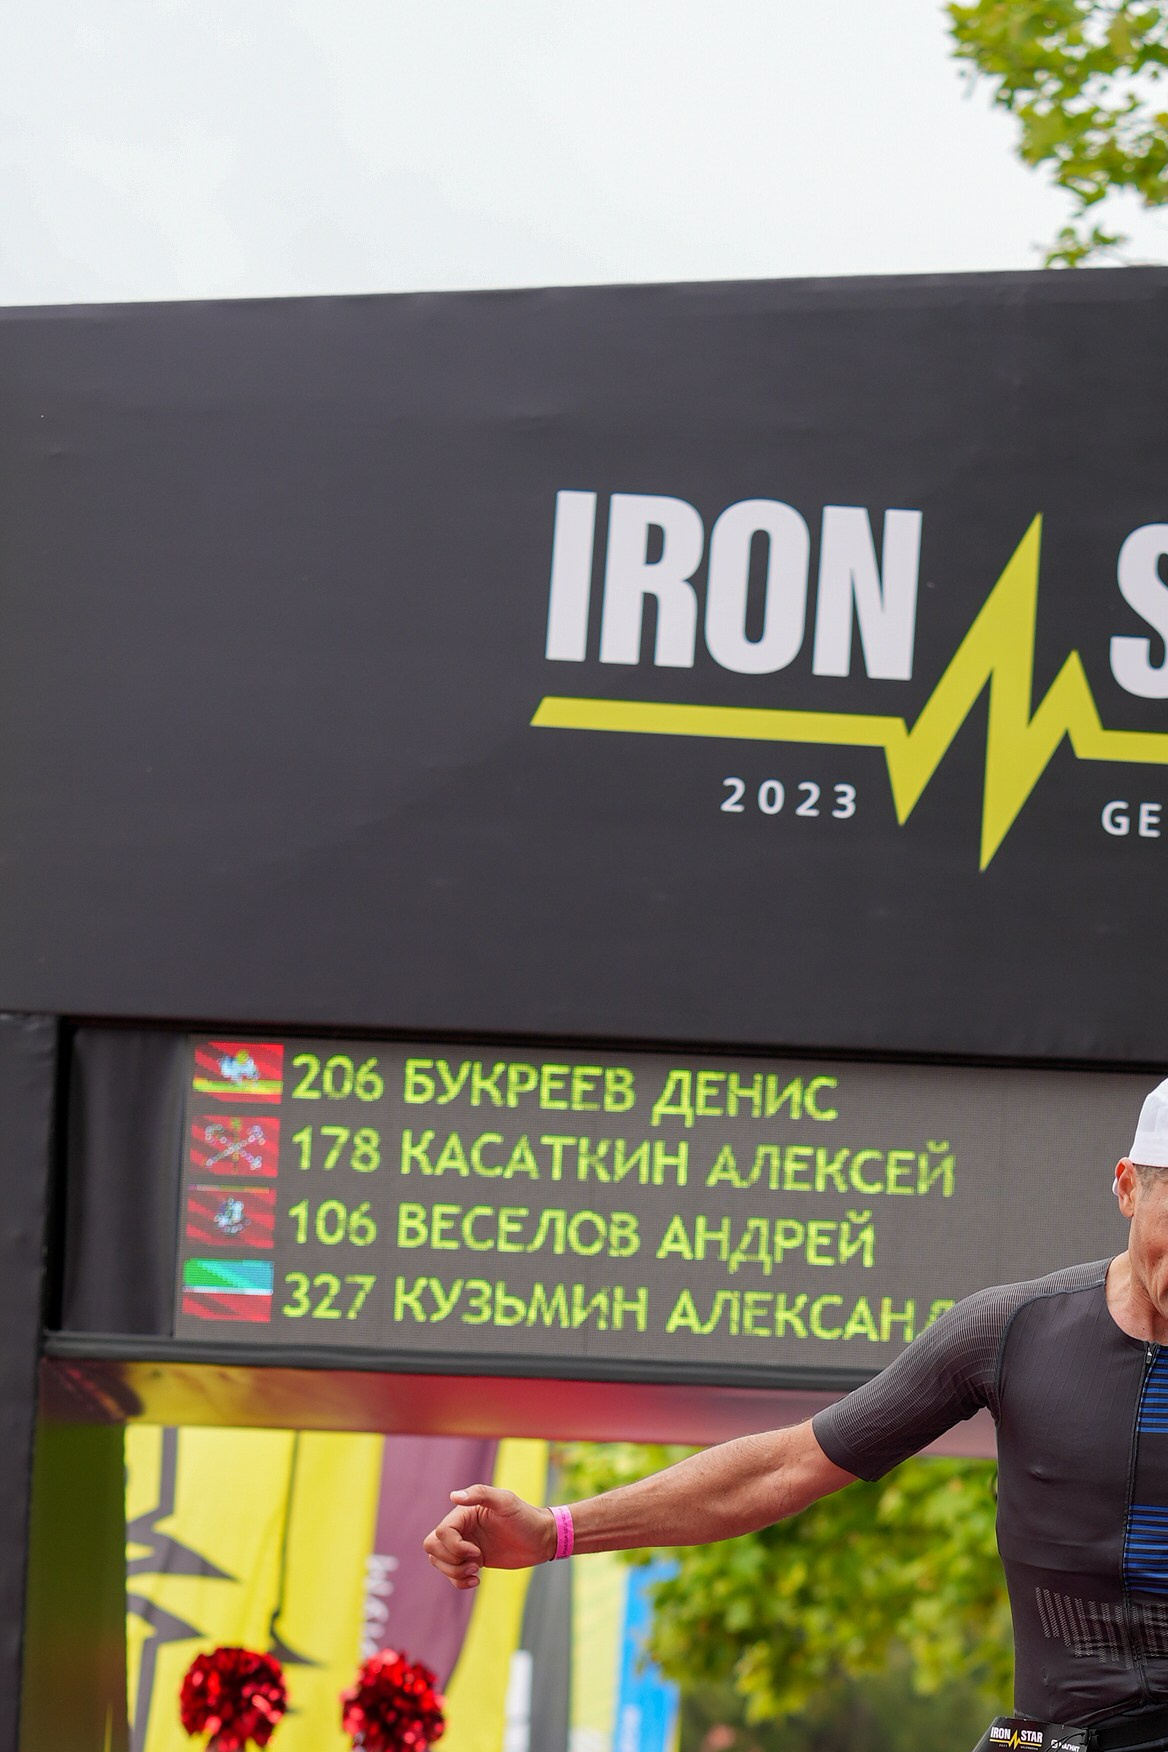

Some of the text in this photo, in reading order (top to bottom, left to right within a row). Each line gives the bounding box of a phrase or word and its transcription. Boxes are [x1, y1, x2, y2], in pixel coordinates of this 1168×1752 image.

[545, 490, 923, 680] IRON
[719, 776, 858, 819] 2023
[291, 1053, 385, 1103] 206
[403, 1057, 638, 1113] БУКРЕЕВ
[651, 1067, 839, 1127] ДЕНИС
[291, 1126, 382, 1174] 178
[399, 1129, 689, 1187] КАСАТКИН
[705, 1138, 957, 1198] АЛЕКСЕЙ
[288, 1200, 378, 1248] 106
[397, 1204, 641, 1259] ВЕСЕЛОВ
[656, 1210, 877, 1275] АНДРЕЙ
[282, 1274, 376, 1321] 327
[394, 1276, 649, 1333] КУЗЬМИН
[990, 1726, 1043, 1743] IRON STAR
